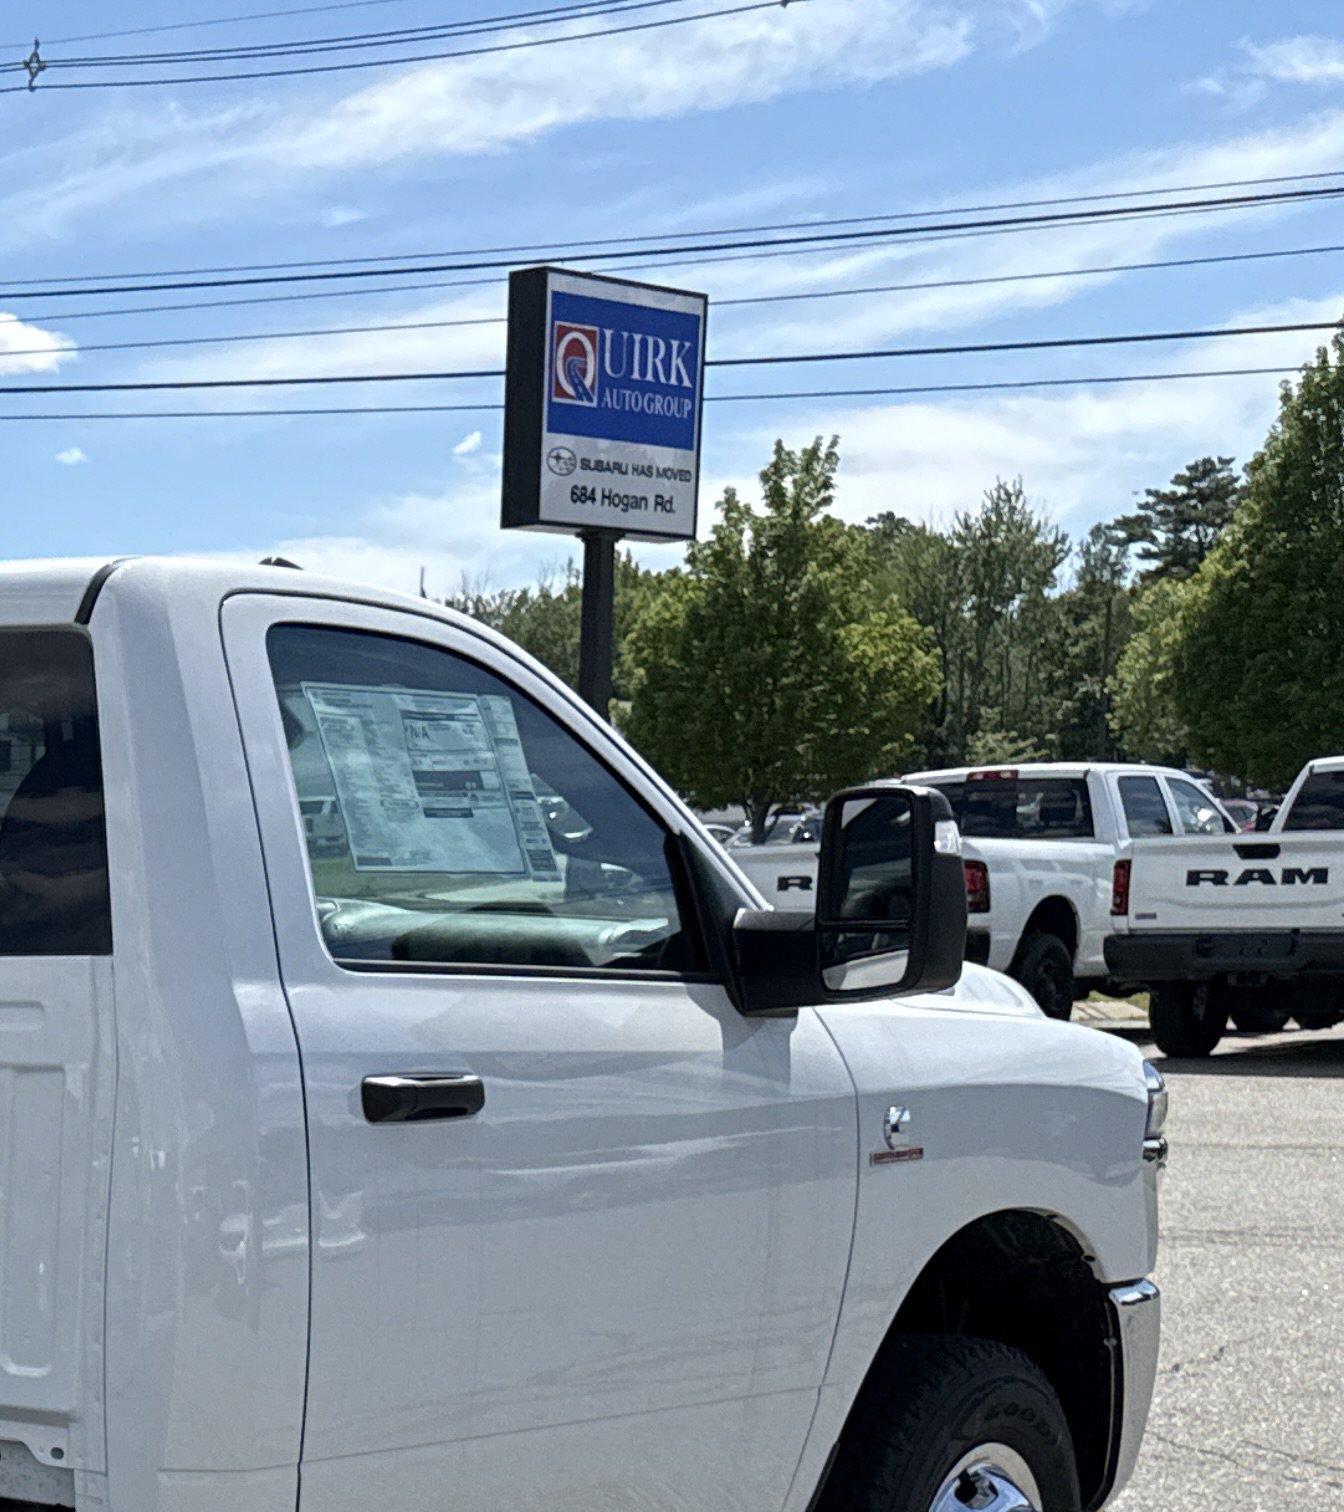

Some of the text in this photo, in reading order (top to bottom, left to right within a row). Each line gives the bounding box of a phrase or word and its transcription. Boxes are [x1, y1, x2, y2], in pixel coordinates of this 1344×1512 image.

[555, 327, 693, 405] QUIRK
[580, 457, 692, 483] SUBARU HAS MOVED
[570, 485, 676, 513] 684 Hogan Rd.
[1186, 867, 1329, 886] RAM
